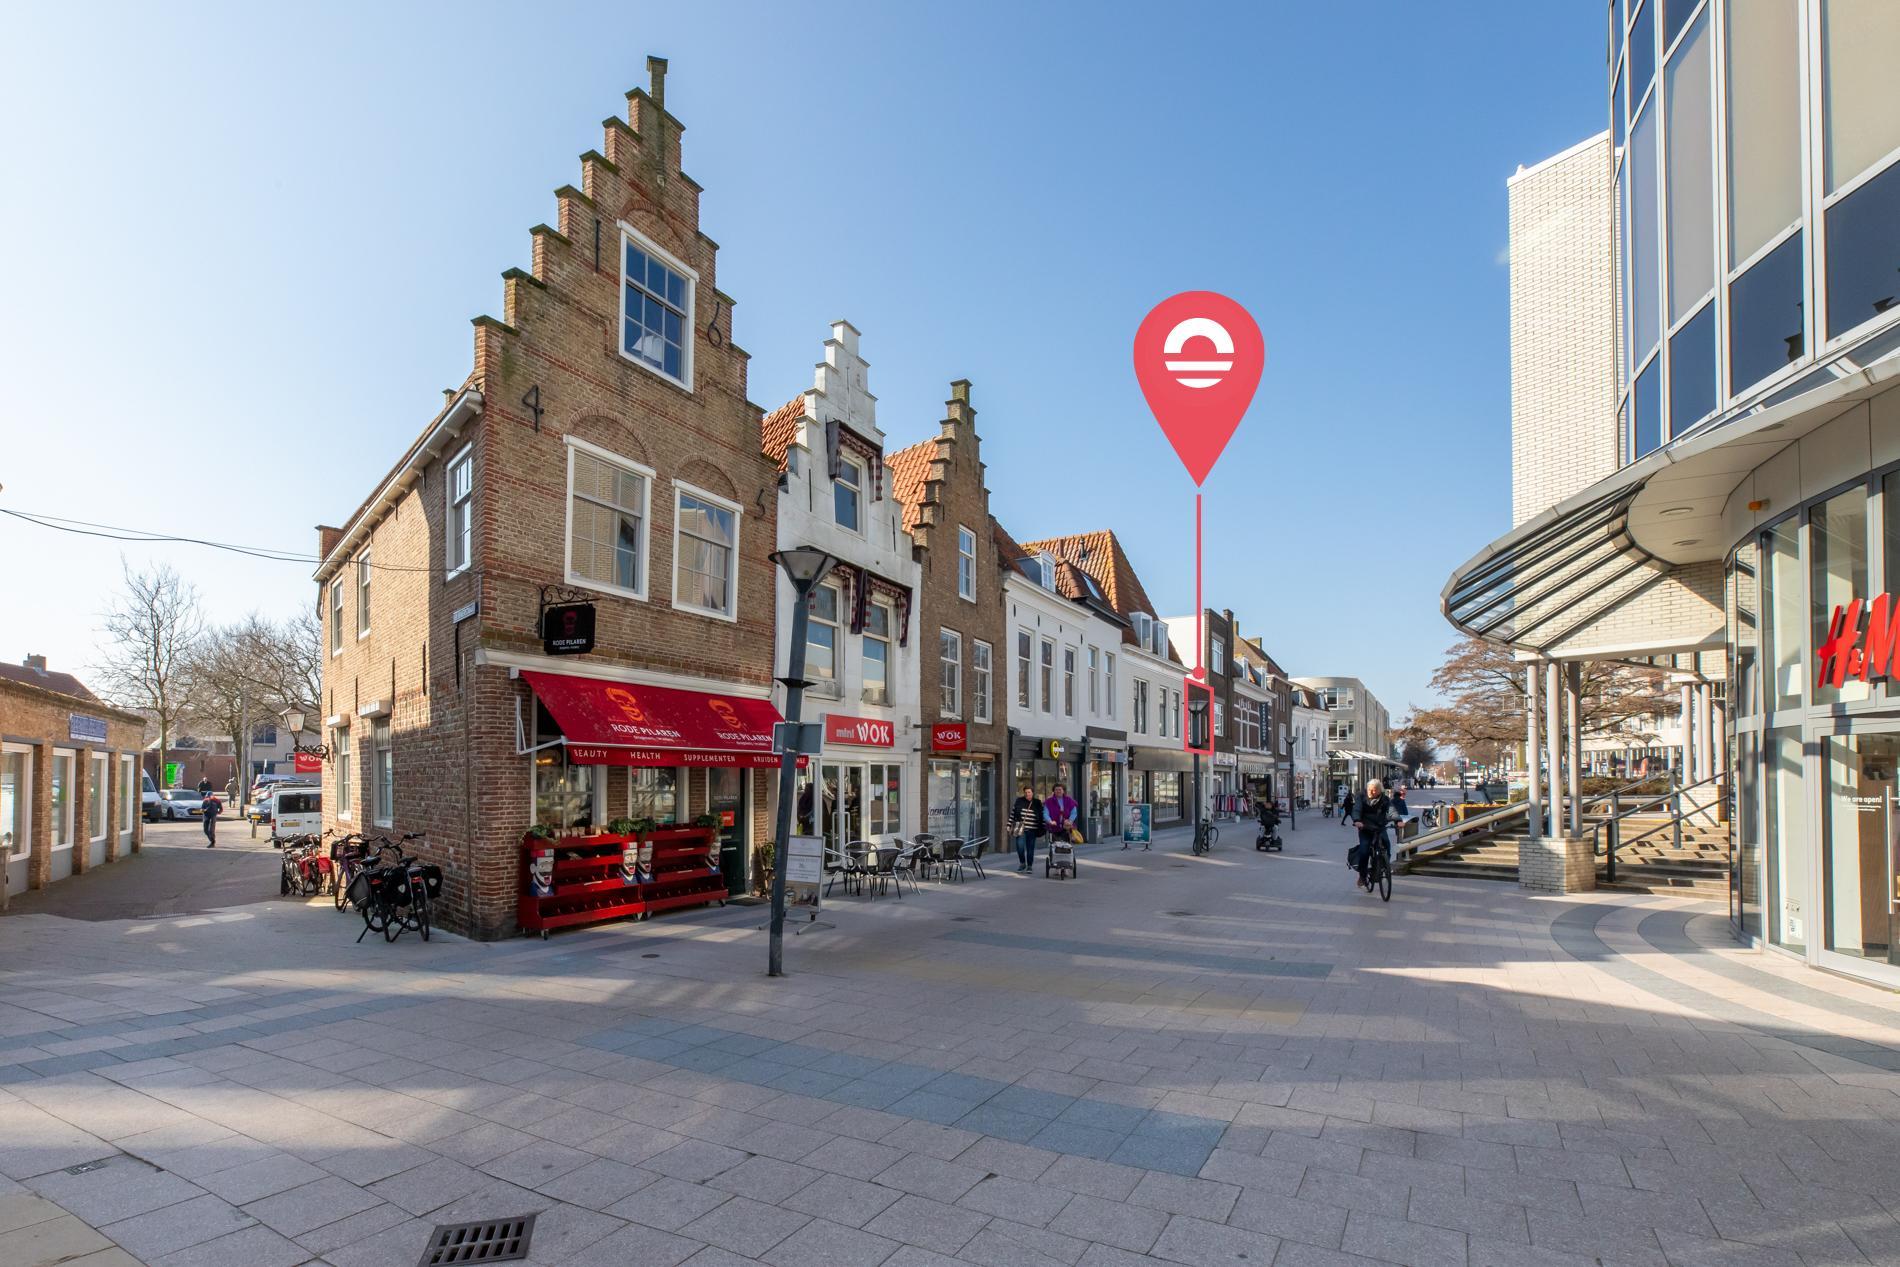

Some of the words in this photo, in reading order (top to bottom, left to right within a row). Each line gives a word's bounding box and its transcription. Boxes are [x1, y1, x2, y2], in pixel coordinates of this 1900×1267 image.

[1816, 592, 1900, 688] H&M
[611, 723, 641, 734] RODE
[640, 729, 682, 738] PILAREN
[717, 731, 741, 740] RODE
[739, 733, 773, 742] PILAREN
[836, 727, 854, 738] mini
[857, 721, 890, 744] WOK
[937, 730, 961, 740] WOK
[573, 749, 608, 758] BEAUTY
[630, 751, 661, 760] HEALTH
[683, 753, 736, 762] SUPPLEMENTEN
[1863, 795, 1882, 804] open!
